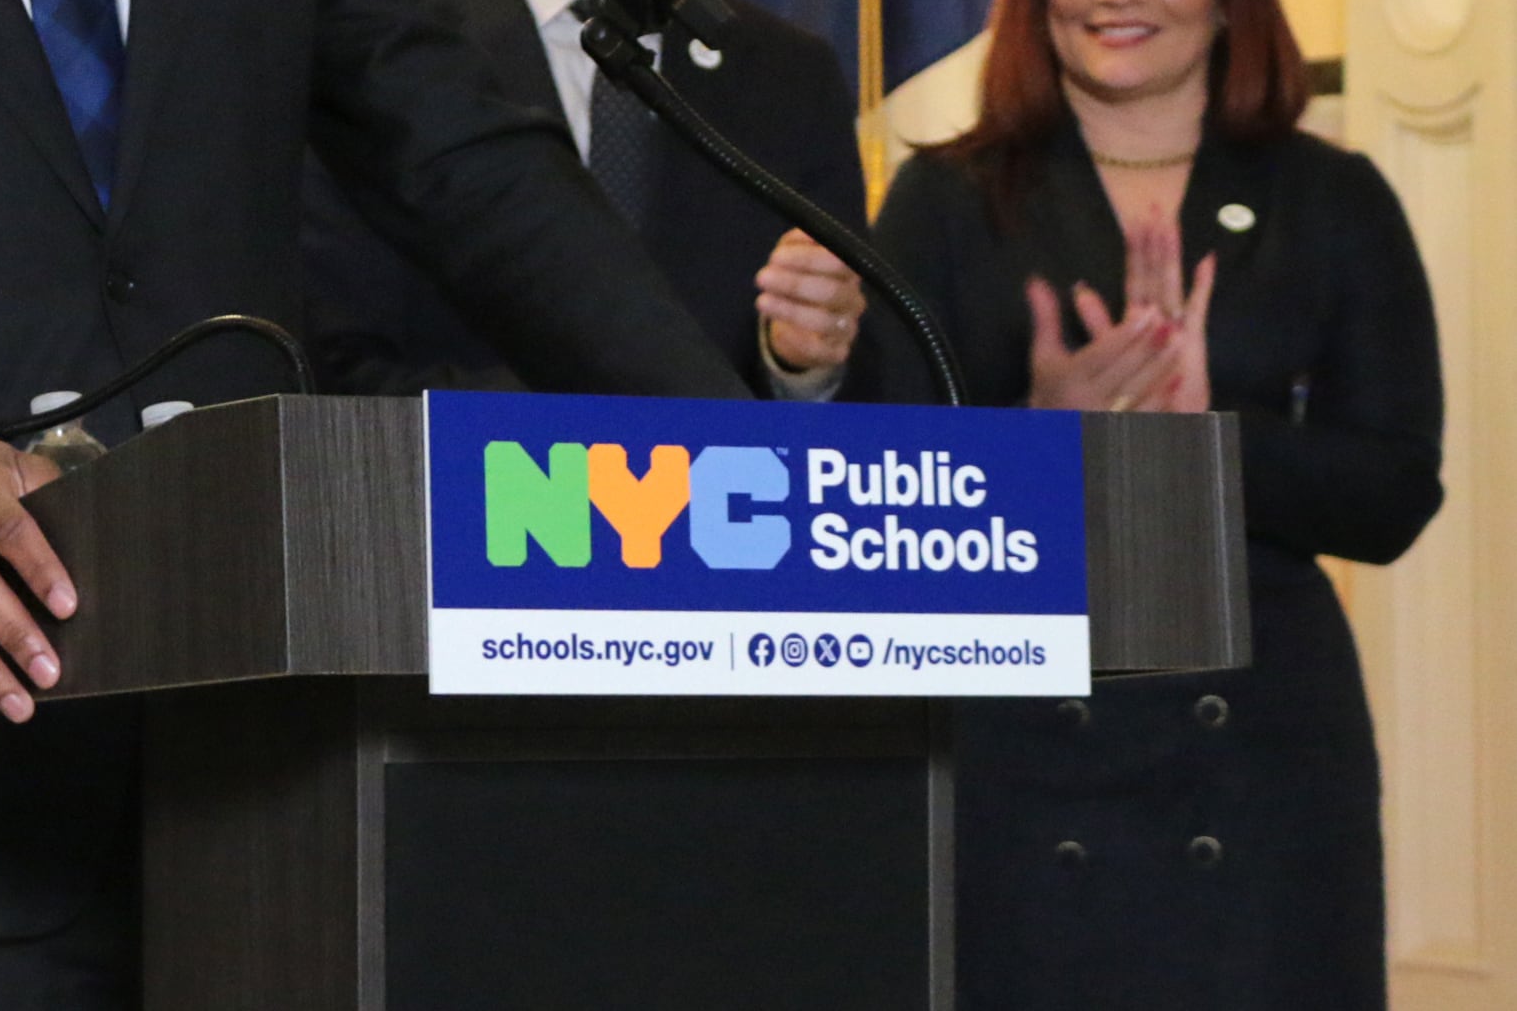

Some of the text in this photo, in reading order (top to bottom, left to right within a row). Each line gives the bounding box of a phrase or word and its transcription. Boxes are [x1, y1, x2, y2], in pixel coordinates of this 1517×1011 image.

[483, 440, 791, 570] NYC
[807, 448, 987, 507] Public
[809, 512, 1039, 573] Schools
[482, 633, 1046, 671] schools.nyc.gov /nycschools
